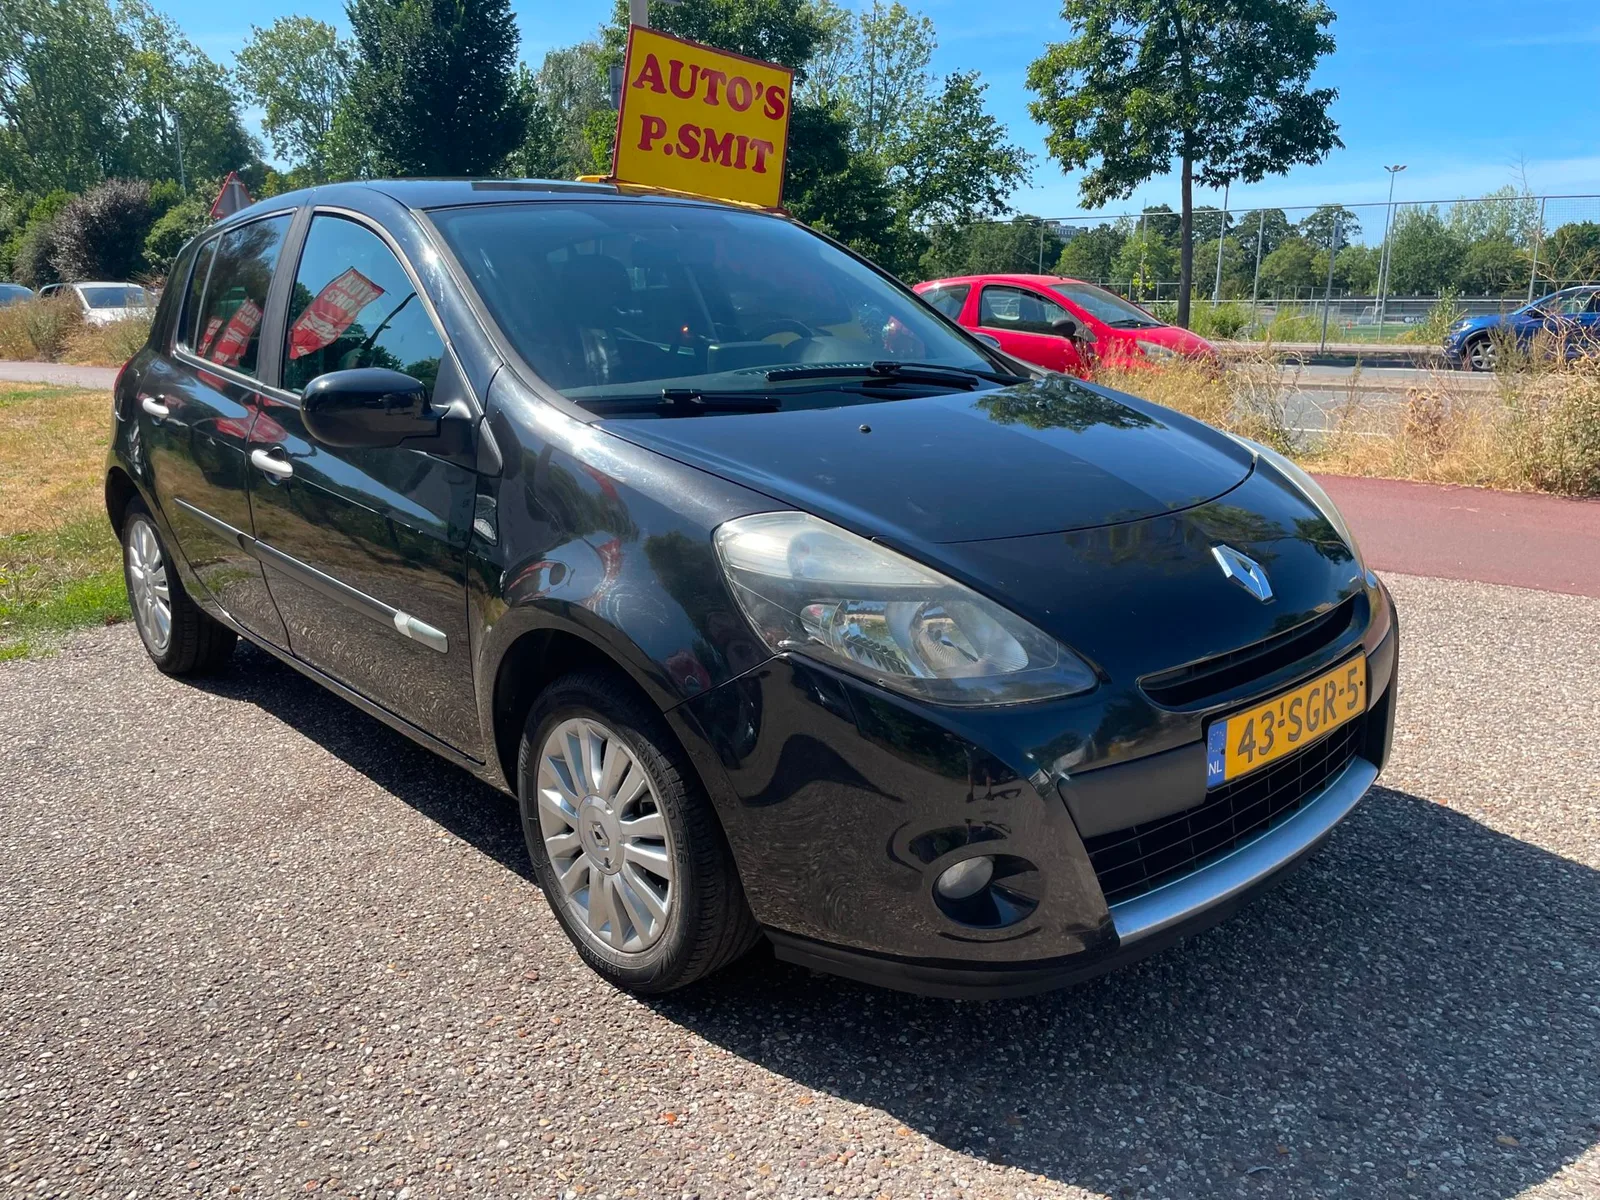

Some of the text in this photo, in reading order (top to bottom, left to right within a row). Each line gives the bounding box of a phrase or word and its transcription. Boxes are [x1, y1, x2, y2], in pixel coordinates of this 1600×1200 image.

[632, 53, 786, 120] AUTO'S
[637, 114, 774, 174] P.SMIT
[1238, 666, 1357, 763] 43-SGR-5
[1208, 760, 1223, 776] NL
